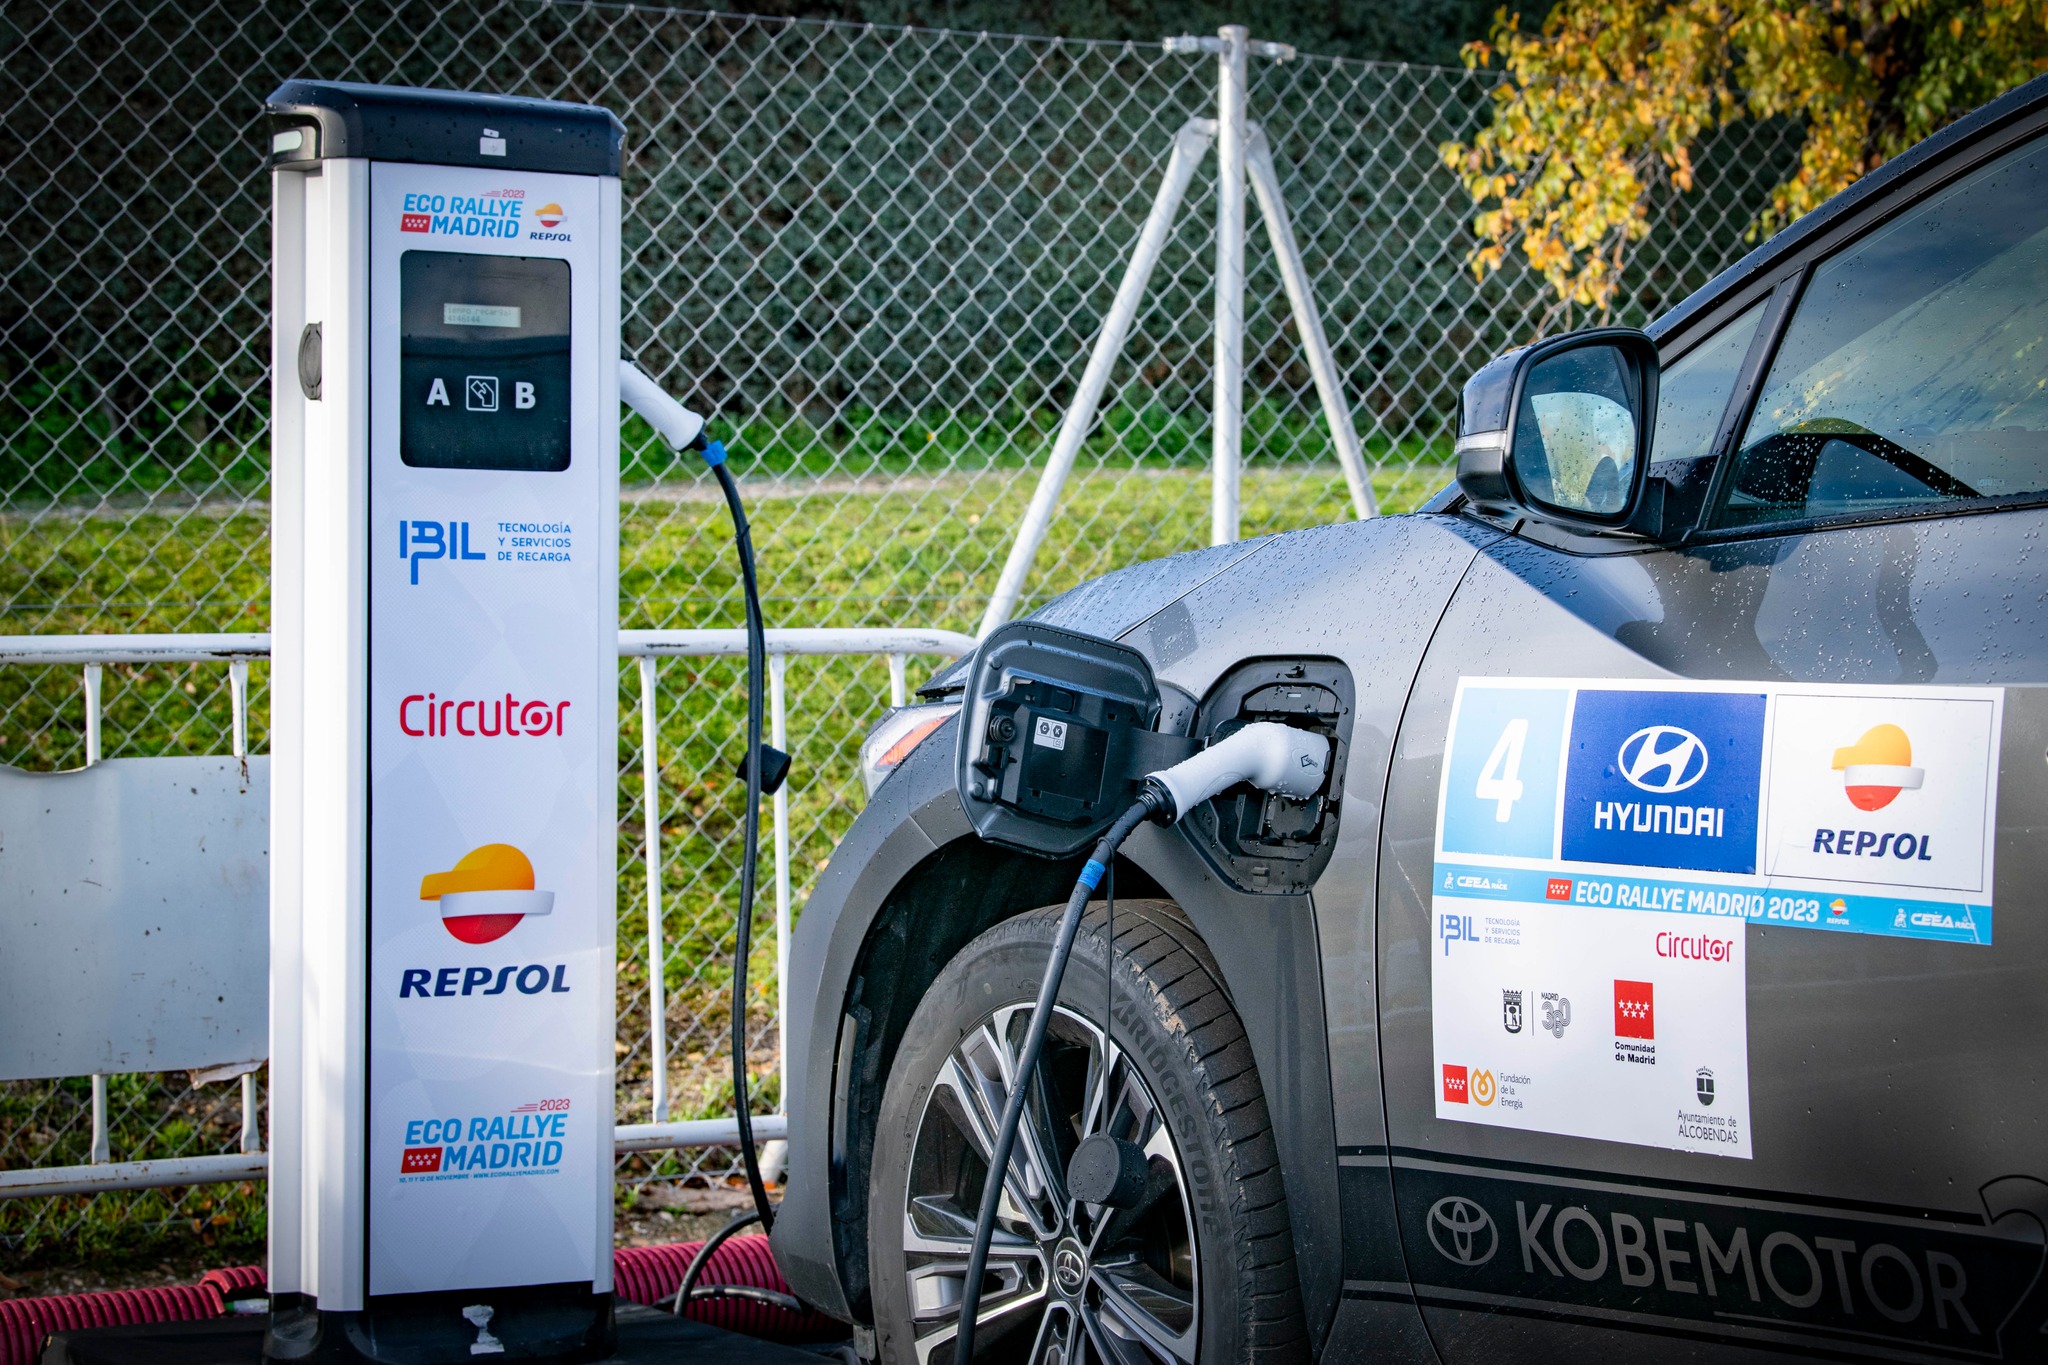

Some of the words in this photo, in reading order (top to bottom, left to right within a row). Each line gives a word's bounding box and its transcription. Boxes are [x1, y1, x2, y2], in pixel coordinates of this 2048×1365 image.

[502, 189, 525, 199] 2023
[403, 193, 445, 213] ECO
[450, 196, 523, 218] RALLYE
[431, 215, 520, 239] MADRID
[529, 231, 572, 242] REPSOL
[426, 378, 450, 406] A
[515, 381, 536, 409] B
[498, 521, 571, 534] TECNOLOGÍA
[498, 537, 505, 546] Y
[511, 538, 571, 548] SERVICIOS
[400, 520, 486, 585] IBIL
[498, 551, 511, 560] DE
[518, 552, 571, 562] RECARGA
[400, 693, 571, 737] Circutor
[1475, 718, 1529, 823] 4
[1594, 801, 1724, 838] HYUNDAI
[1812, 828, 1933, 862] REPSOL
[1575, 881, 1612, 905] ECO
[1616, 883, 1684, 911] RALLYE
[1687, 890, 1765, 918] MADRID
[1767, 897, 1820, 922] 2023
[1485, 917, 1520, 927] TECNOLOGÍA
[1826, 917, 1850, 926] REPSOL
[1440, 914, 1480, 956] IBIL
[1491, 928, 1520, 936] SERVICIOS
[1494, 937, 1520, 945] RECARGA
[1656, 931, 1733, 962] Circutor
[399, 964, 571, 998] REPSOL
[1541, 991, 1559, 1001] MADRID
[1615, 1041, 1655, 1053] Comunidad
[1615, 1053, 1625, 1062] de
[1627, 1053, 1655, 1065] Madrid
[1500, 1073, 1531, 1085] Fundación
[1500, 1085, 1509, 1094] de
[1509, 1086, 1515, 1095] la
[539, 1098, 571, 1111] 2023
[1501, 1097, 1523, 1110] Energía
[1677, 1109, 1725, 1126] Ayuntamiento
[1728, 1115, 1737, 1127] de
[405, 1118, 462, 1145] ECO
[468, 1113, 568, 1142] RALLYE
[1678, 1125, 1738, 1144] ALCOBENDAS
[442, 1140, 563, 1172] MADRID
[473, 1168, 560, 1179] WWW.ECORALLYEMADRID.COM
[1516, 1198, 1982, 1336] KOBEMOTOR
